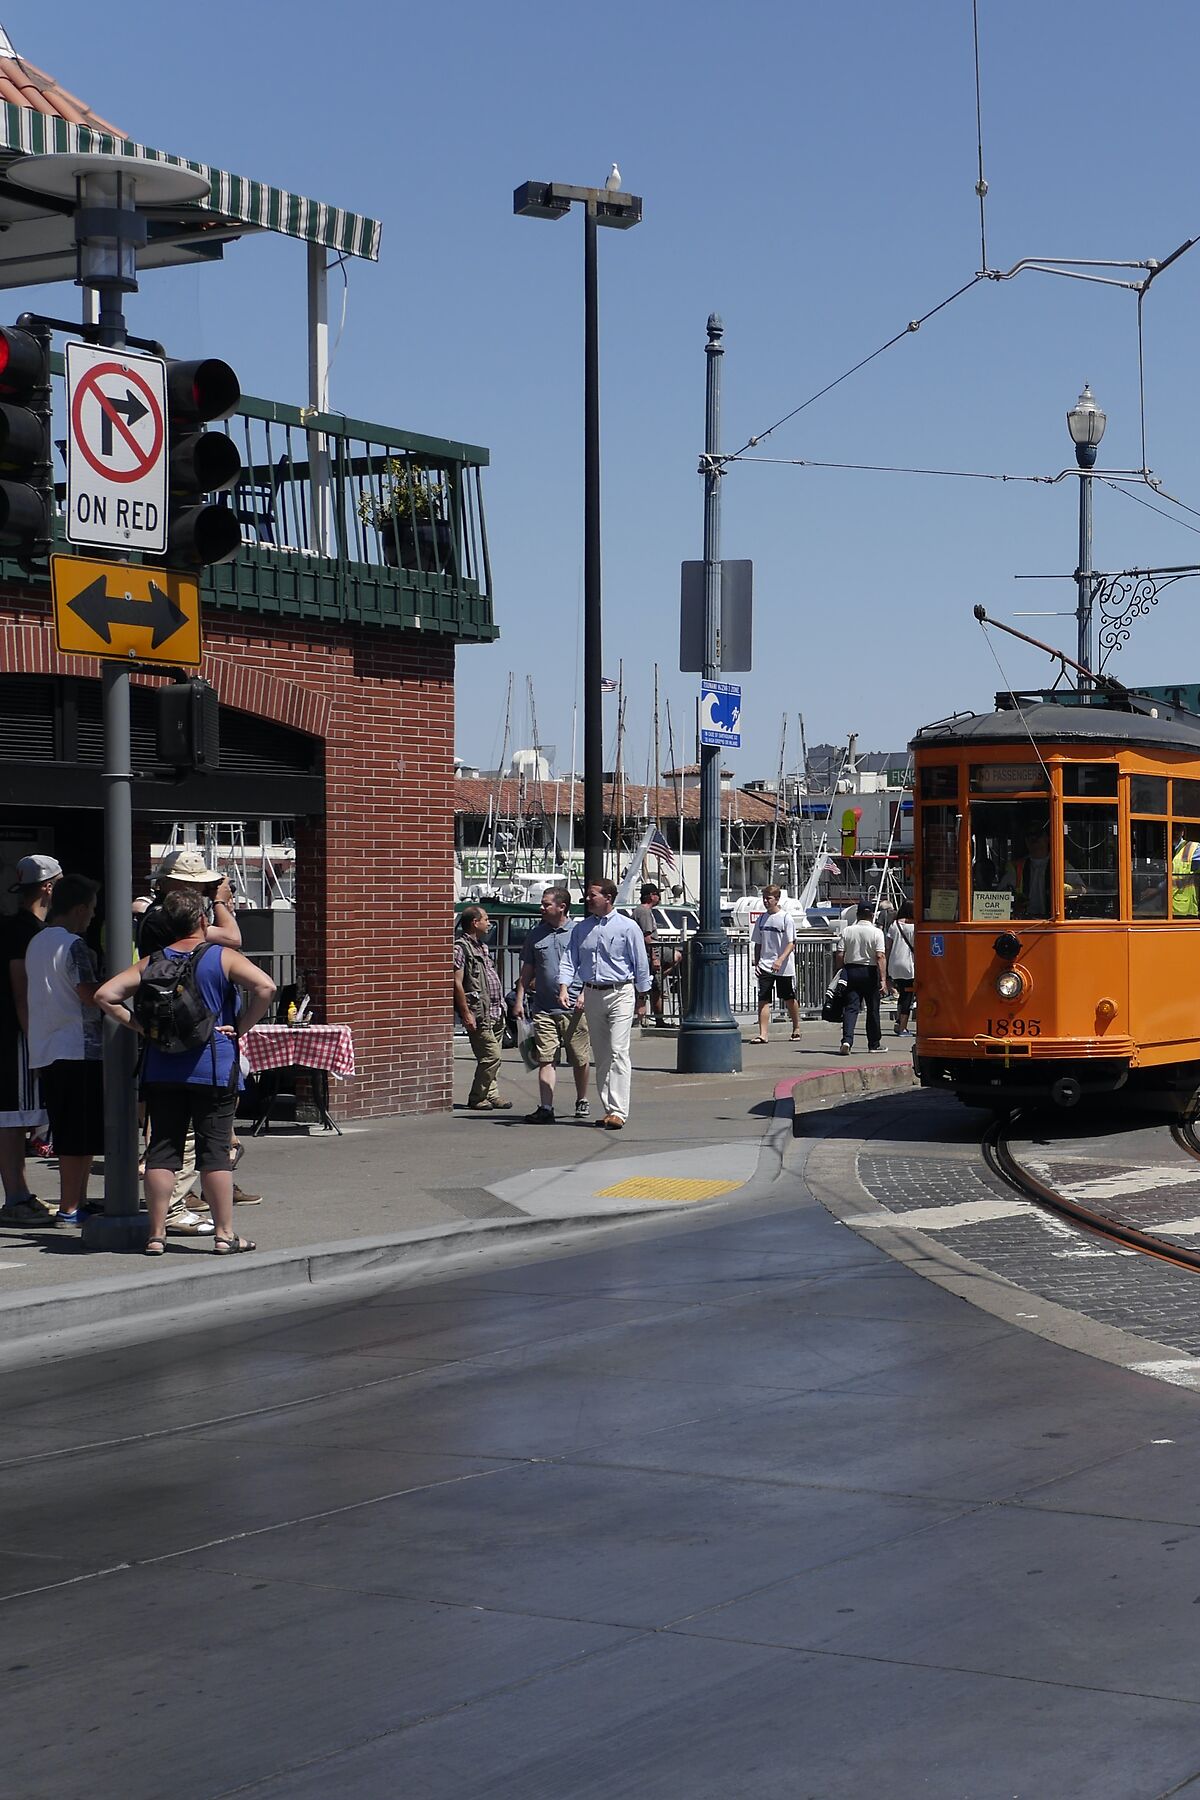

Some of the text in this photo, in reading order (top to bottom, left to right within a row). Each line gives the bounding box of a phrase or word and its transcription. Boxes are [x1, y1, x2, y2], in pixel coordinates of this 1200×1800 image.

[77, 493, 158, 531] ON RED
[987, 1019, 1041, 1037] 1895
